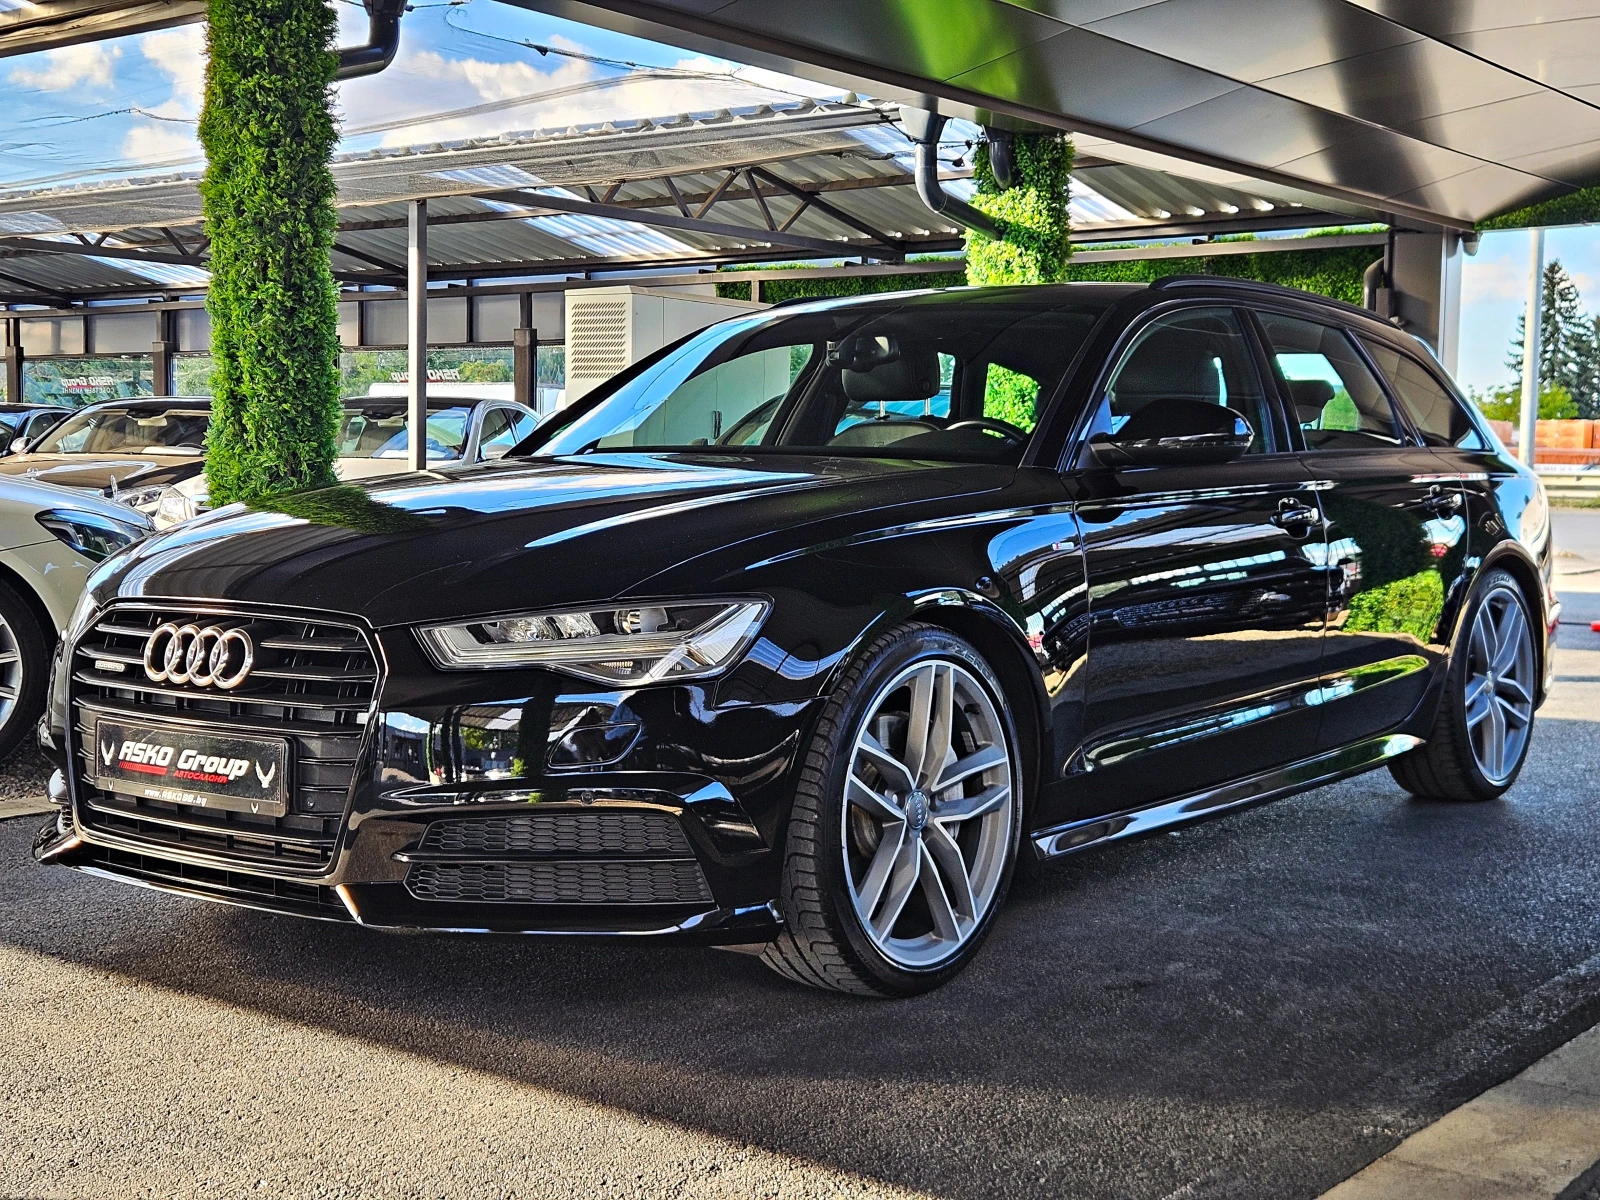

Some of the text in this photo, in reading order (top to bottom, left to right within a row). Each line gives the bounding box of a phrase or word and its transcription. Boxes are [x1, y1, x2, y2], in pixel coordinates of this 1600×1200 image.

[118, 740, 250, 781] ASKO Group
[172, 769, 228, 784] АВТОСАЛОНИ
